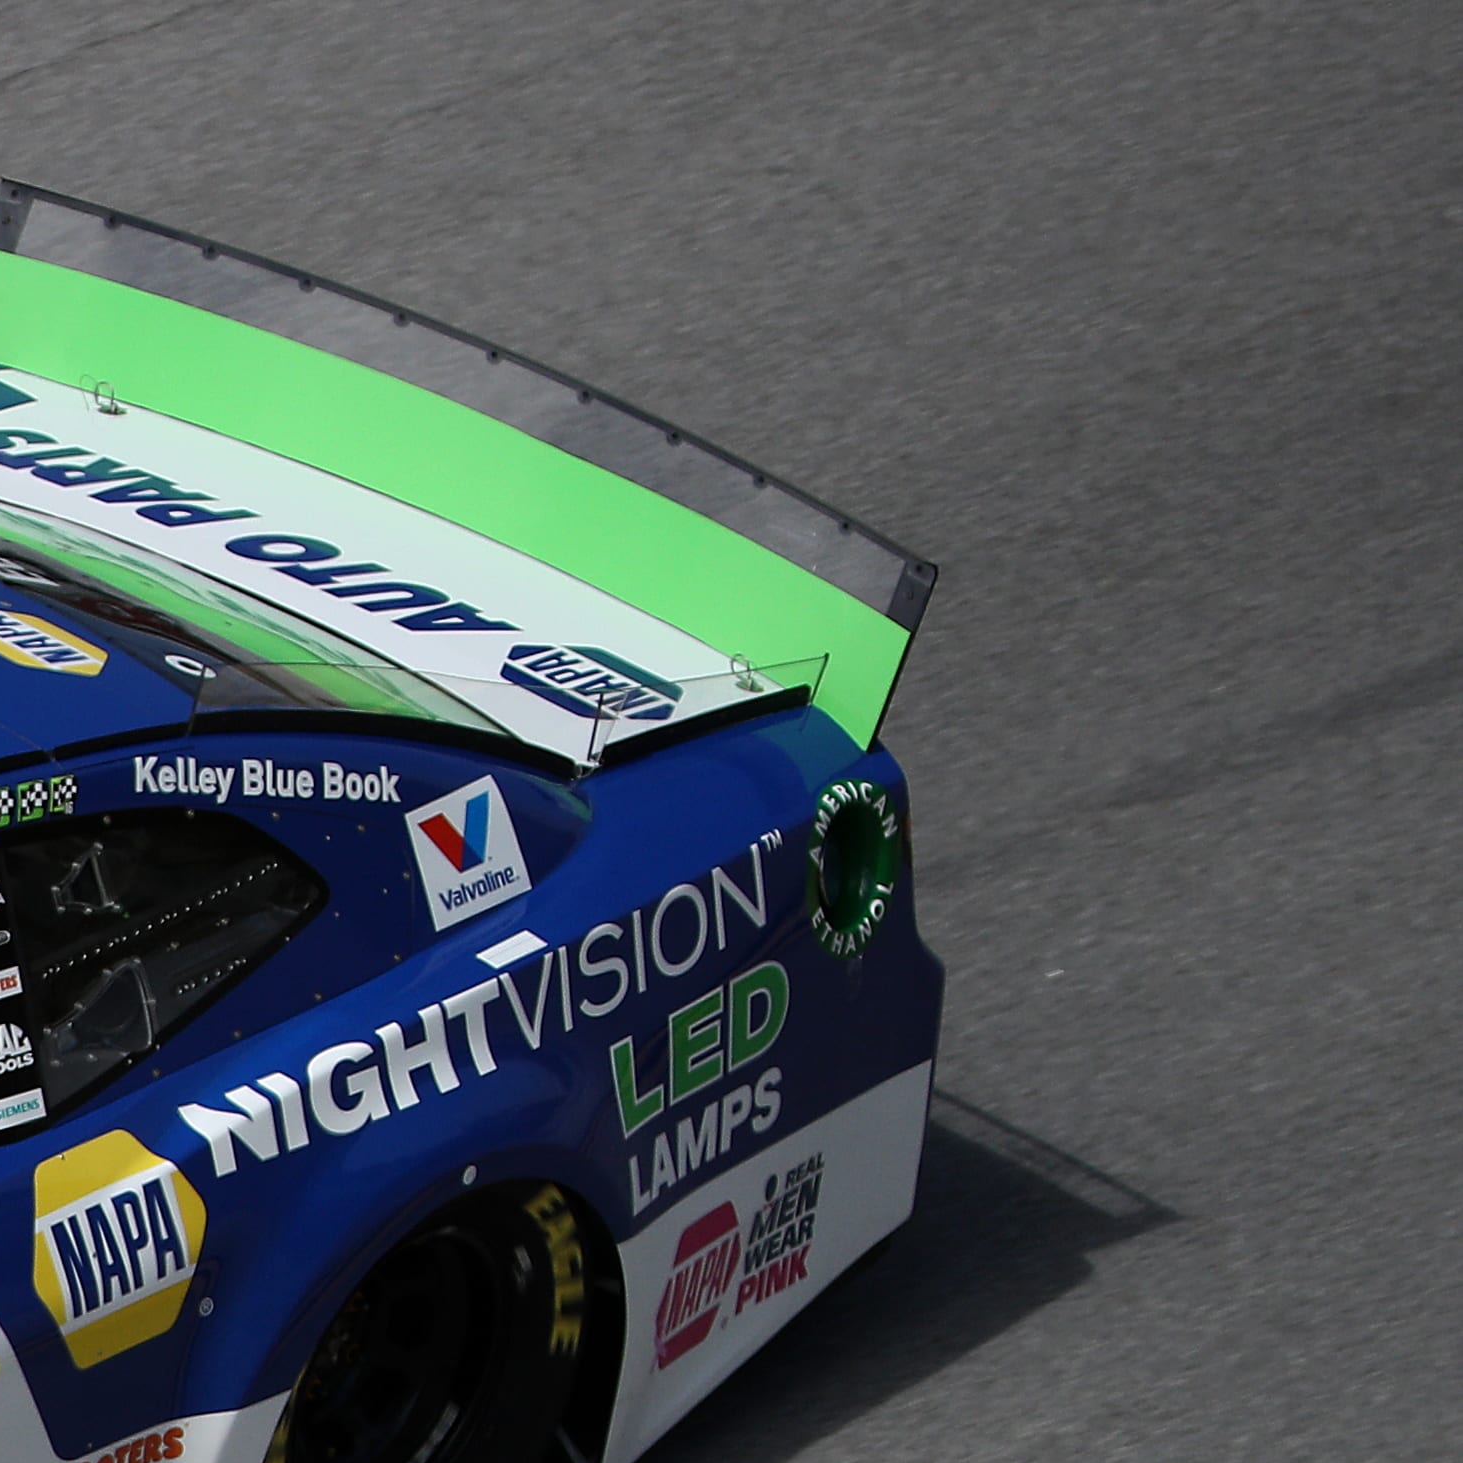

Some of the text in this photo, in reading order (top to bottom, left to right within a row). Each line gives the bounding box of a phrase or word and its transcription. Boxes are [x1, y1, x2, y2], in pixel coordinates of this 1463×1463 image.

[227, 534, 526, 632] AUTO
[523, 649, 662, 713] NAPA
[134, 755, 401, 803] Kelley Blue Book
[809, 781, 899, 870] AMERICAN
[438, 866, 521, 911] Valvoline
[812, 882, 895, 954] ETHANOL
[609, 960, 790, 1139] LED
[629, 1066, 784, 1217] LAMPS
[784, 1152, 826, 1189] REAL
[743, 1213, 816, 1276] WEAR
[747, 1172, 824, 1245] MEN
[50, 1177, 187, 1320] NAPA
[734, 1246, 810, 1316] PINK
[665, 1237, 731, 1337] NAPA
